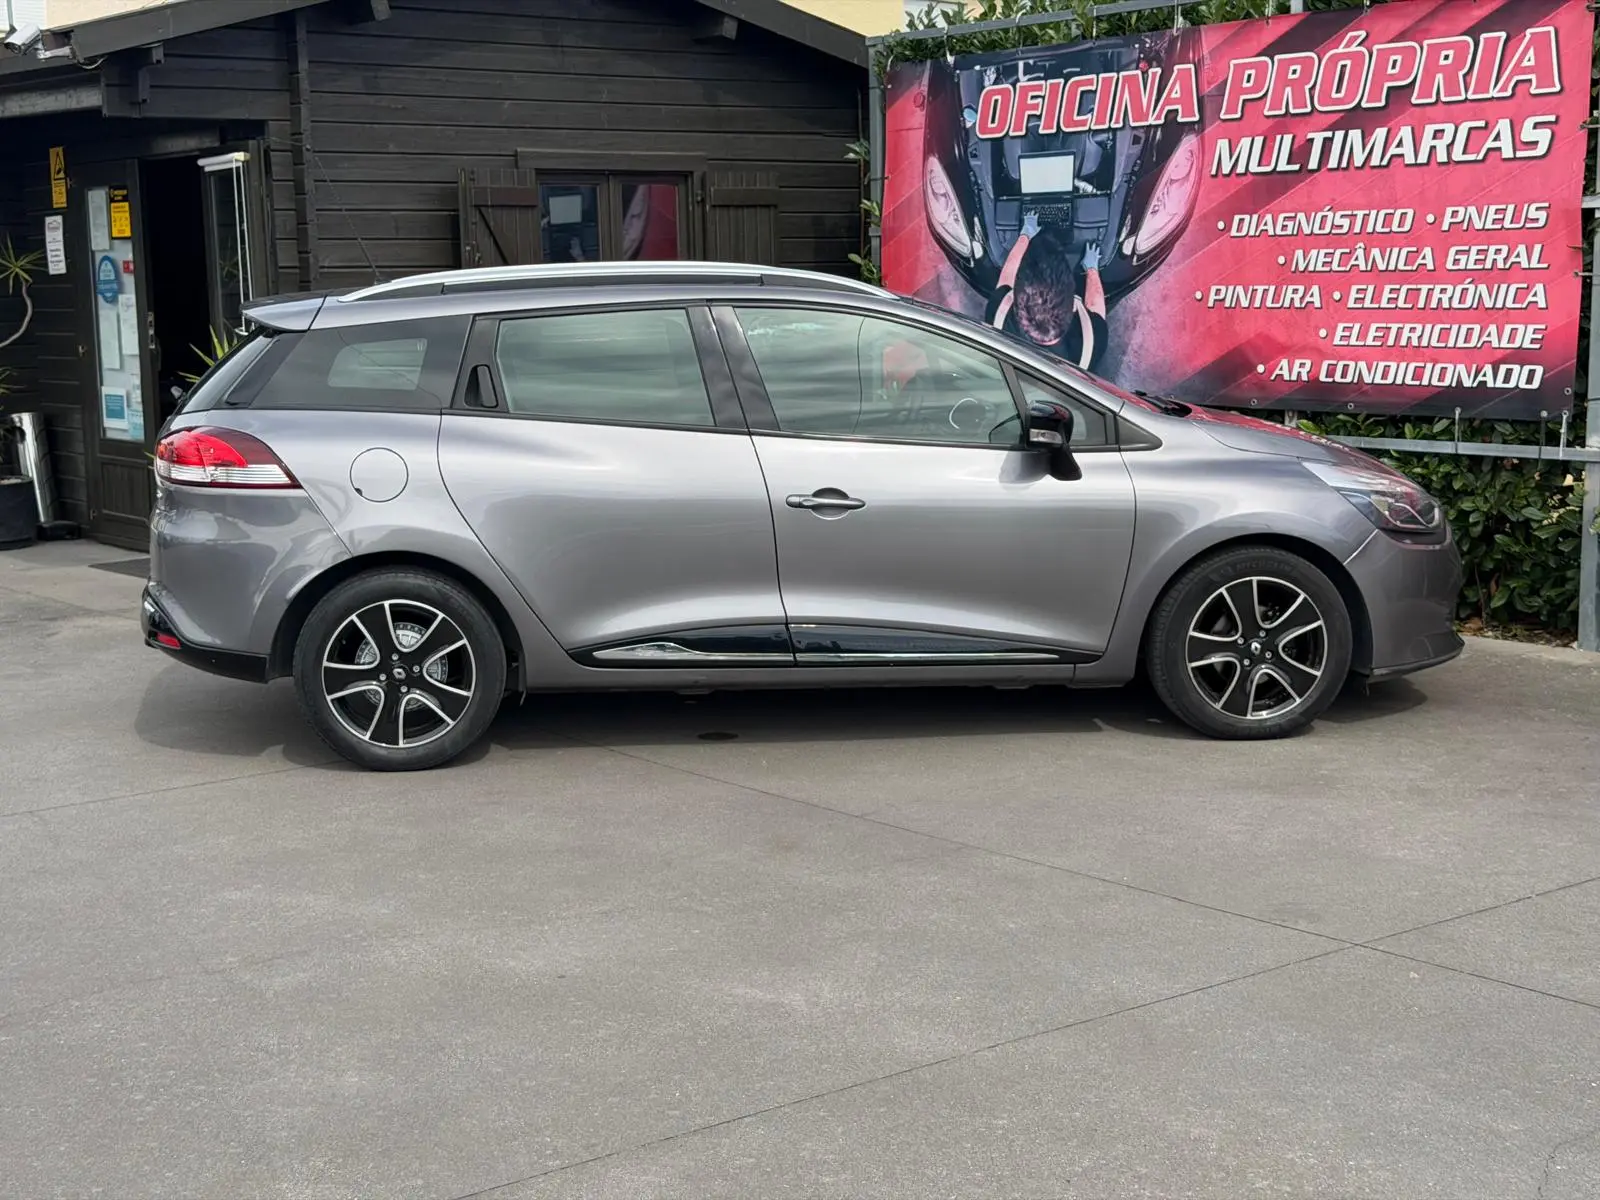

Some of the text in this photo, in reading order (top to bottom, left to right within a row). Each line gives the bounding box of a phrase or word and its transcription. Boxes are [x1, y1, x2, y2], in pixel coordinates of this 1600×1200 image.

[976, 26, 1562, 138] OFICINA PRÓPRIA
[1210, 115, 1557, 176] MULTIMARCAS
[1230, 202, 1550, 237] DIAGNÓSTICO PNEUS
[1291, 242, 1550, 272] MECÂNICA GERAL
[1207, 278, 1547, 310] PINTURA ELECTRÓNICA
[1332, 322, 1546, 349] ELETRICIDADE
[1270, 358, 1544, 390] AR CONDICIONADO
